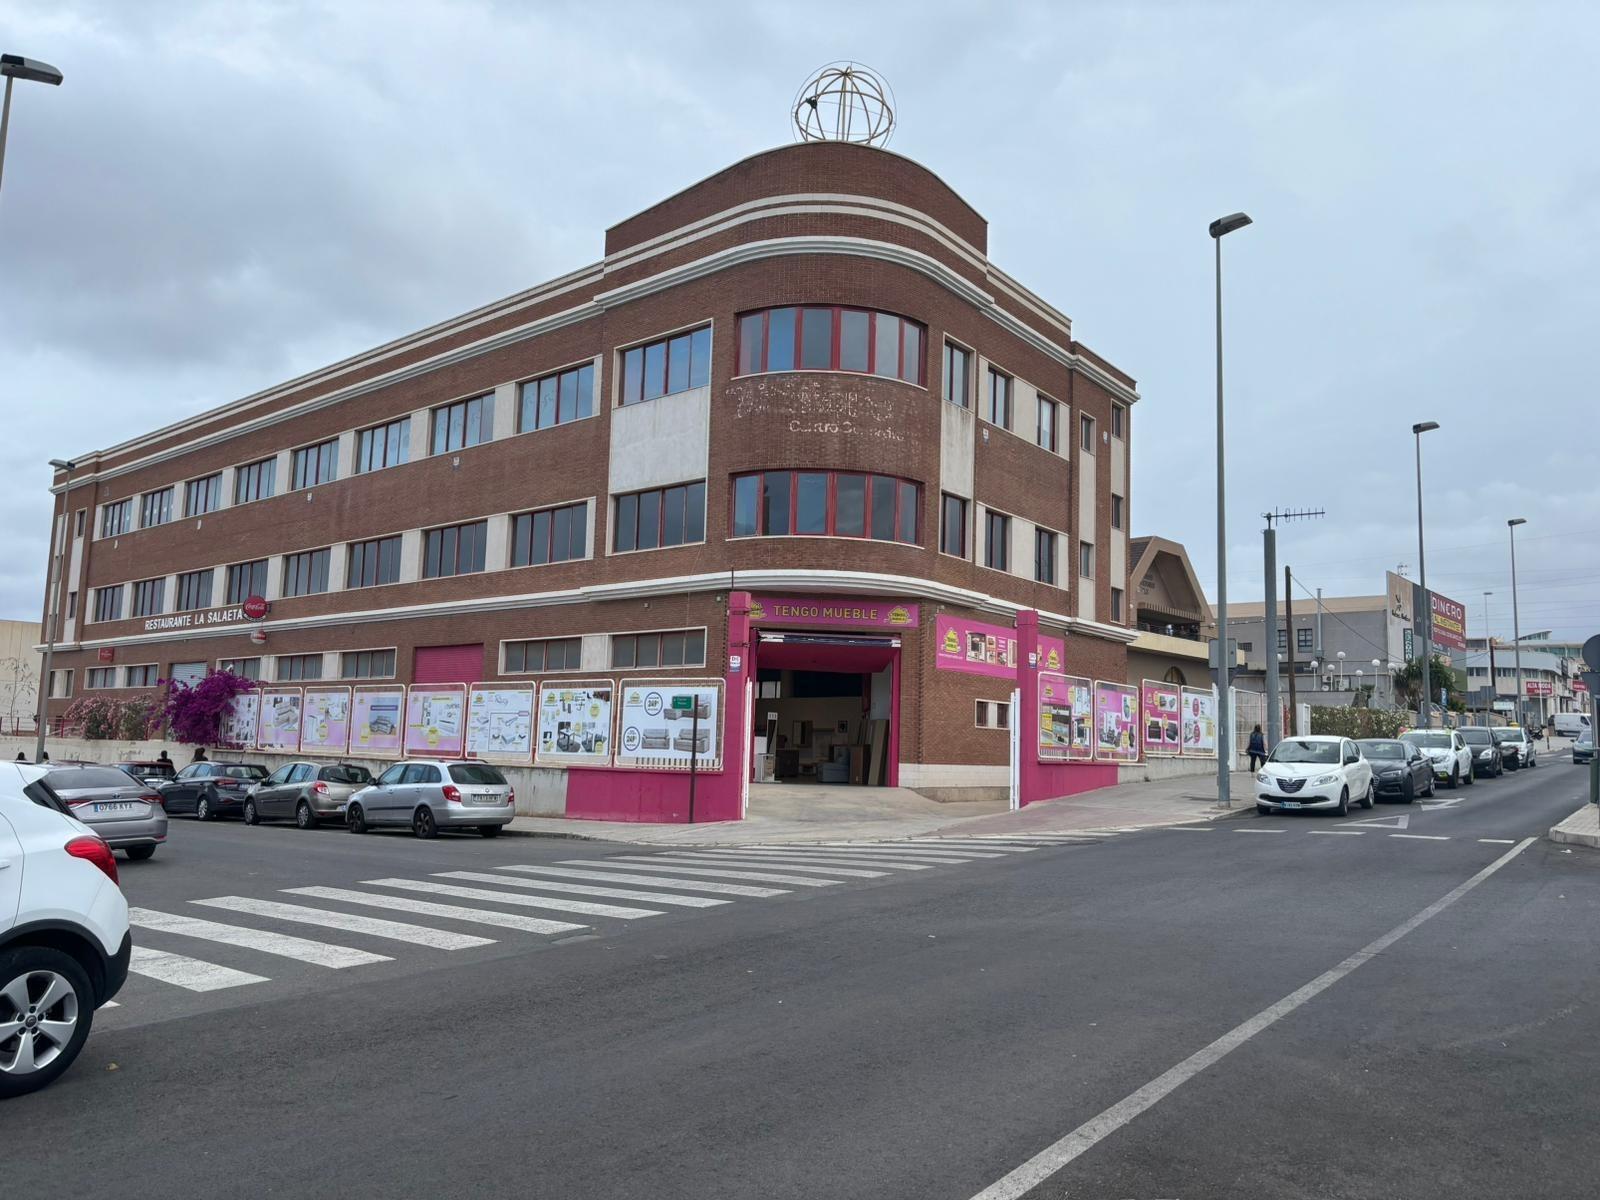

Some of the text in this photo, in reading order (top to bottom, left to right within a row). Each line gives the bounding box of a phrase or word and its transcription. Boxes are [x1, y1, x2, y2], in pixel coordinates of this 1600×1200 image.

[145, 609, 243, 630] RESTAURANTE LA SALAETA
[773, 605, 819, 617] TENGO
[823, 607, 878, 620] MUEBLE
